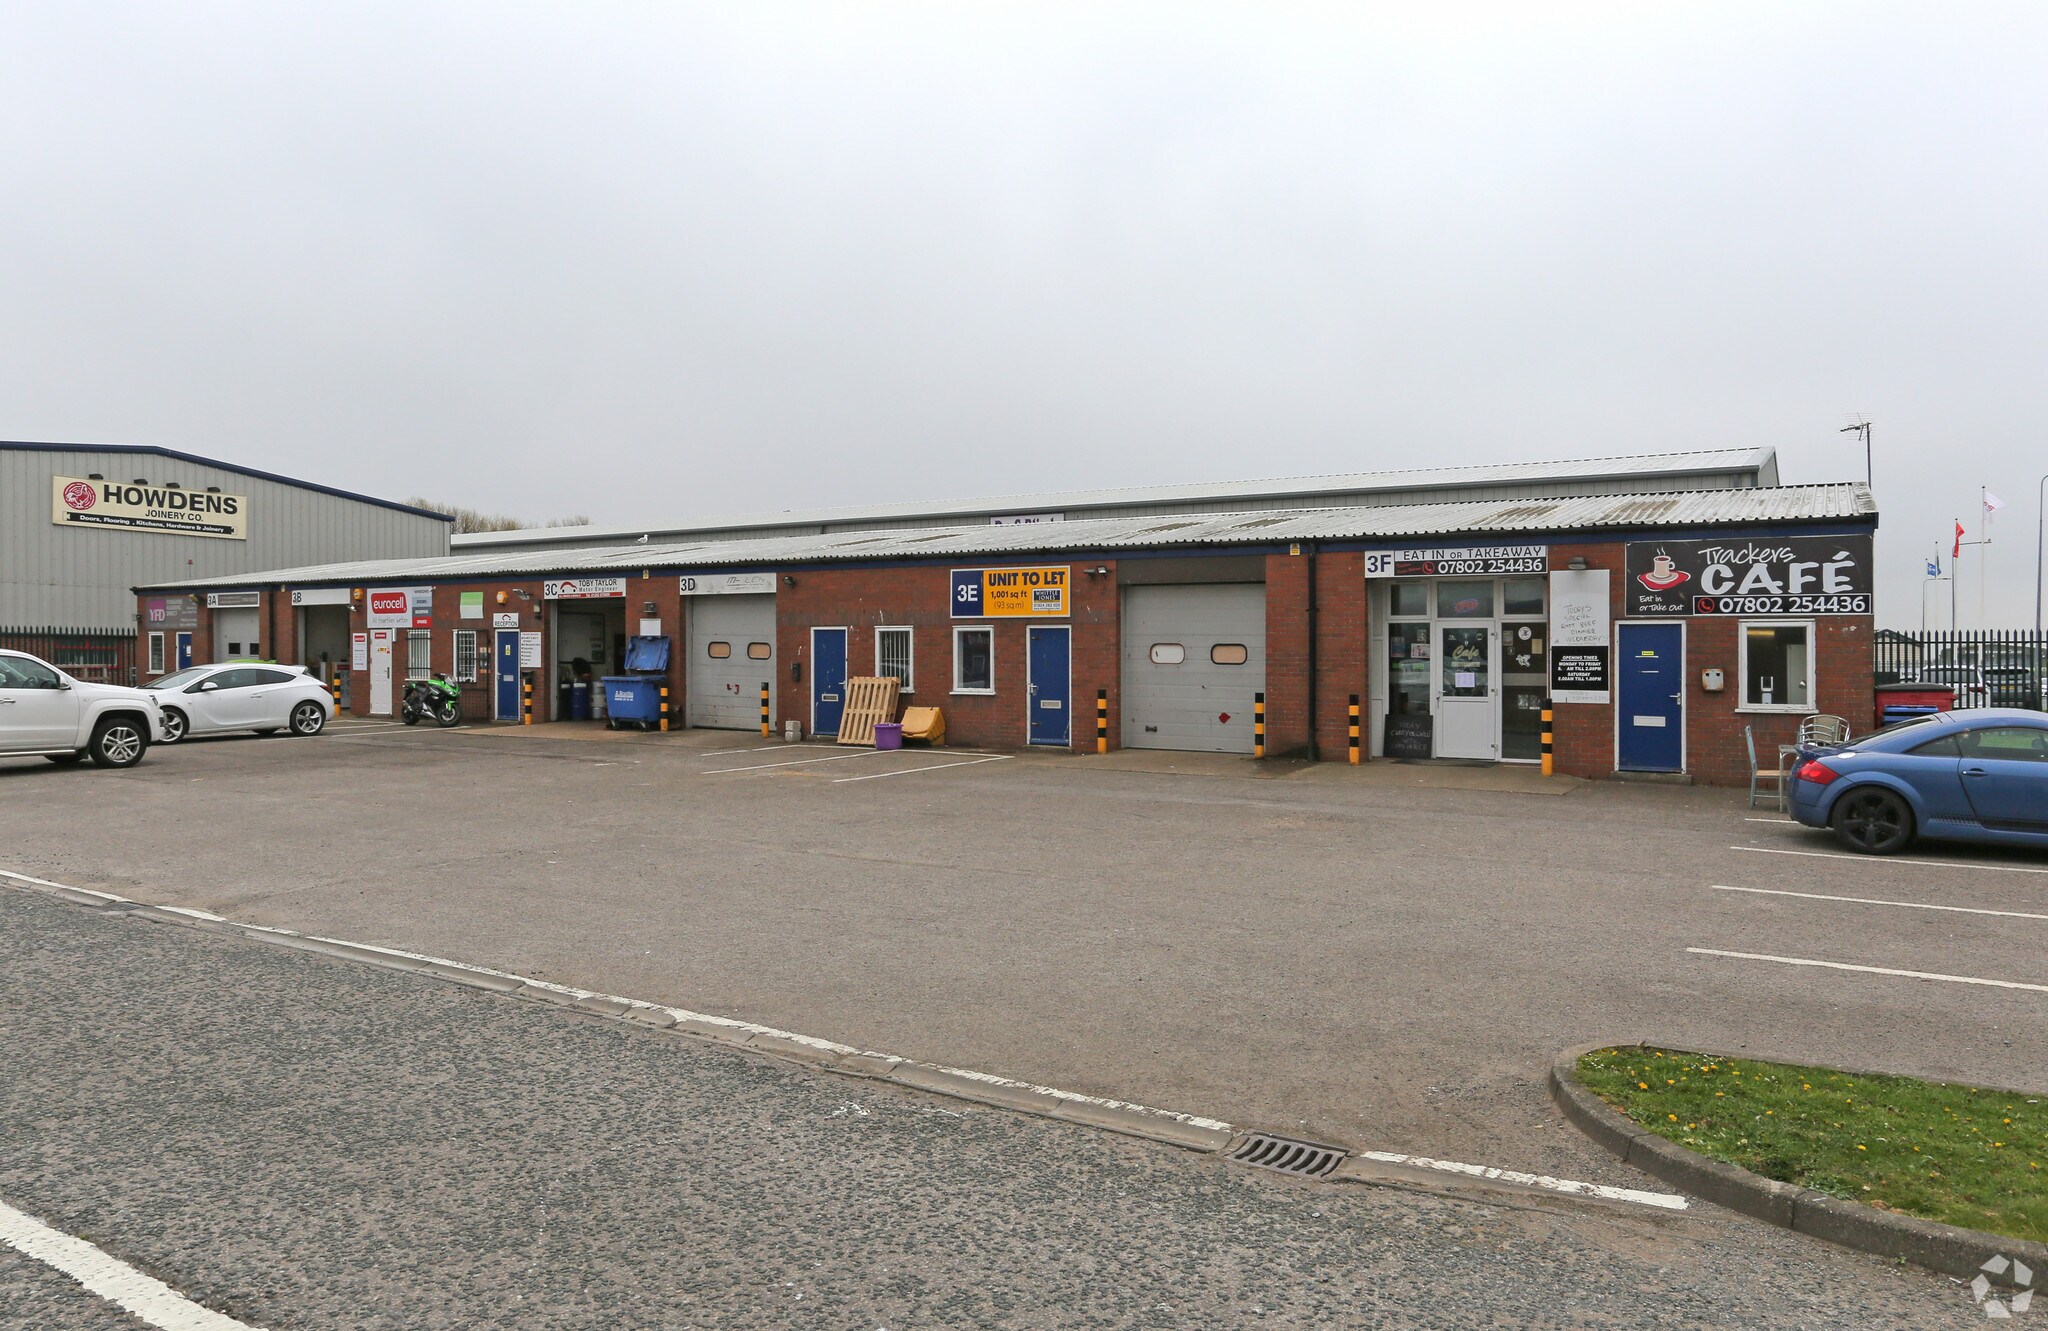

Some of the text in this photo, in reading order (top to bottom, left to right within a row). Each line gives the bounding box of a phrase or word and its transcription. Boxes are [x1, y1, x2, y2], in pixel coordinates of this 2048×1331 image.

[103, 484, 238, 514] HOWDENS
[79, 515, 102, 523] Doors,
[104, 517, 130, 525] Flooring
[136, 520, 165, 528] Kitchens,
[166, 523, 196, 531] Hardware
[145, 509, 203, 522] JOINERY CO.
[1403, 550, 1427, 561] EAT
[1432, 549, 1445, 560] IN
[1467, 546, 1542, 559] TAKEAWAY
[1698, 543, 1796, 565] Trackers
[1366, 554, 1392, 574] 3F
[1438, 560, 1484, 574] 07802
[1488, 558, 1543, 572] 254436
[988, 571, 1065, 587] UNIT TO LET
[1700, 551, 1855, 594] CAFÉ
[544, 583, 558, 596] 3C
[579, 578, 618, 587] TOBY TAYLOR
[680, 577, 696, 592] 3D
[207, 595, 217, 606] 3A
[292, 592, 302, 603] 3B
[957, 584, 978, 602] 3E
[990, 590, 1028, 600] 1,001 sq ft
[1639, 594, 1662, 603] Eat in
[373, 597, 404, 609] eurocell
[993, 601, 1025, 610] (93 sq m)
[1648, 603, 1668, 612] Take
[1669, 603, 1684, 611] Out
[1719, 596, 1866, 613] 07802 254436
[1452, 645, 1480, 660] Cafe
